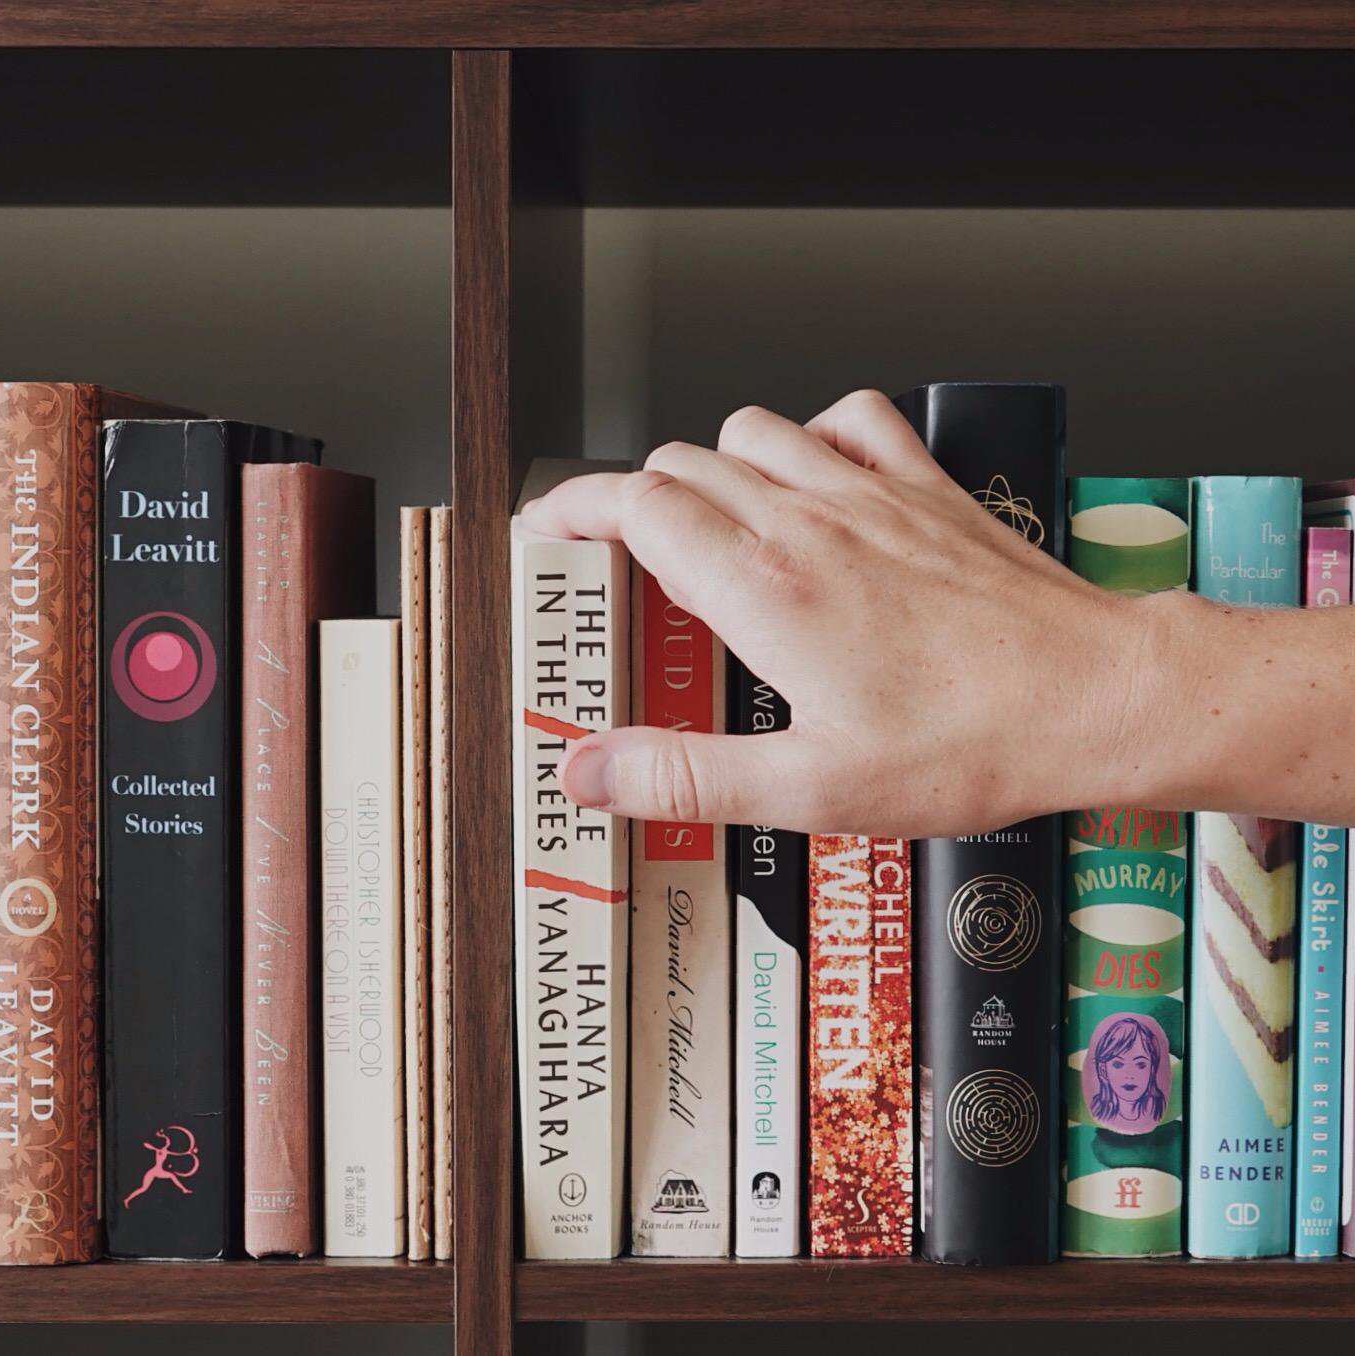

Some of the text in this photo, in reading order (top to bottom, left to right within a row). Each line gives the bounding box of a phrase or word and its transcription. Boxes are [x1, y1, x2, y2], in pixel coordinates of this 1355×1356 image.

[118, 490, 211, 520] David
[111, 534, 221, 564] Leavitt
[1321, 550, 1340, 580] The
[575, 584, 606, 658] THE
[536, 573, 567, 707] IN THE
[11, 523, 41, 850] INDIAN CLERK
[111, 774, 217, 798] Collected
[124, 813, 204, 836] Stories
[1074, 863, 1184, 897] MURRAY
[355, 781, 383, 1078] CHRISTOPHER ISHERWOOD
[1312, 881, 1340, 952] Skirt
[1093, 950, 1162, 990] DIES
[538, 897, 569, 1167] YANAGIHARA
[577, 964, 607, 1100] HANYA
[972, 1030, 1013, 1038] RANDOM
[977, 1039, 1008, 1047] HOUSE
[28, 986, 55, 1123] DAVID
[754, 952, 778, 1146] David Mitchell
[1311, 991, 1330, 1174] AIMEE BENDER
[1218, 1137, 1285, 1153] AIMEE
[1200, 1165, 1285, 1181] BENDER
[550, 1213, 593, 1223] ANCHOR
[554, 1225, 589, 1234] BOOKS
[640, 1219, 722, 1231] Random House
[750, 1216, 783, 1224] Random
